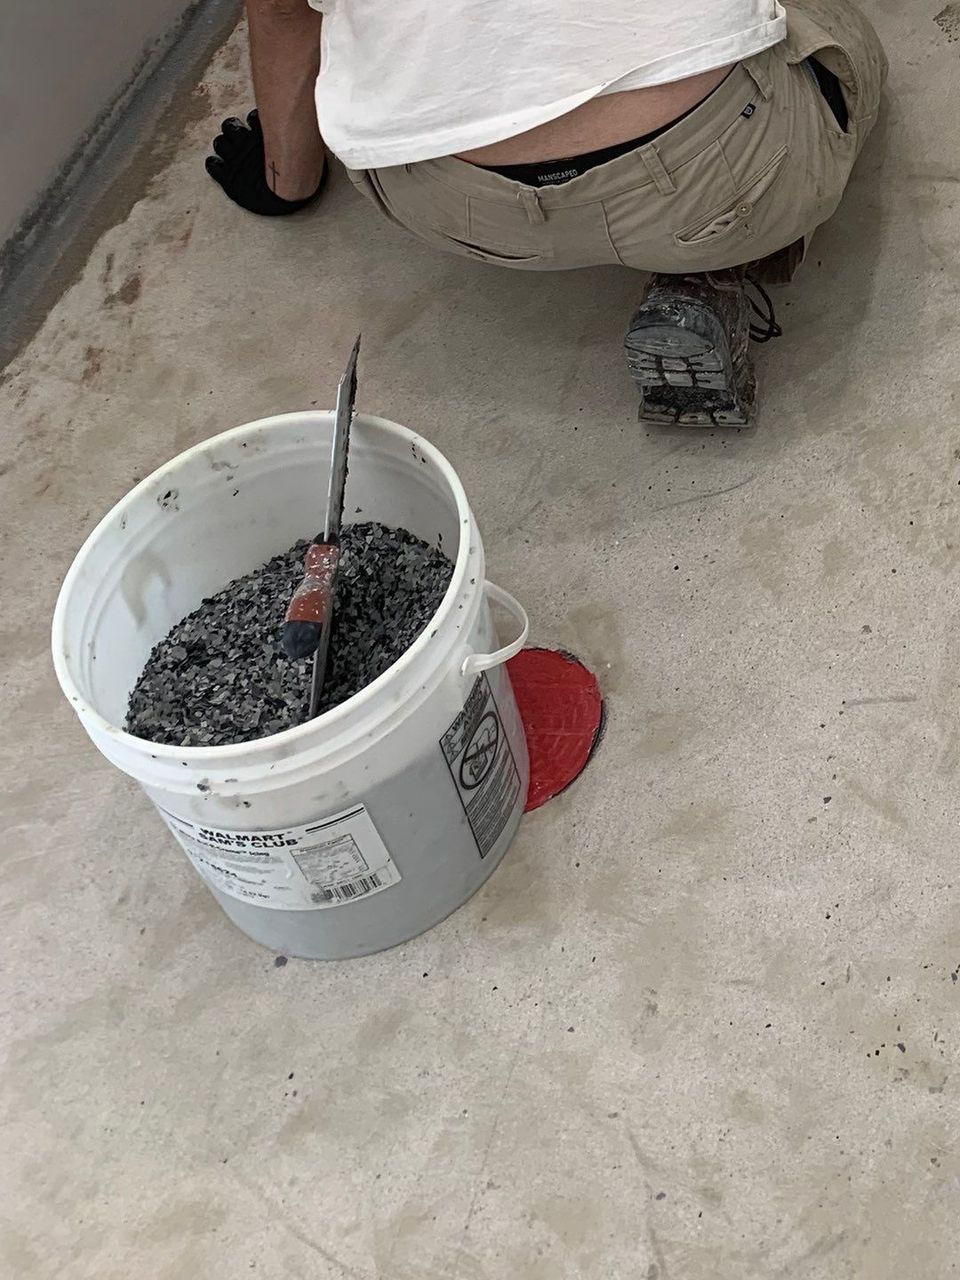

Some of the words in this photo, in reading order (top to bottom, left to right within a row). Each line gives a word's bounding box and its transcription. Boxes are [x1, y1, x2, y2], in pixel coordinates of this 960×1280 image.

[537, 169, 578, 181] MANSCAPED
[198, 832, 247, 848] SAM'S
[250, 838, 298, 848] CLUB
[199, 827, 285, 841] WALMART
